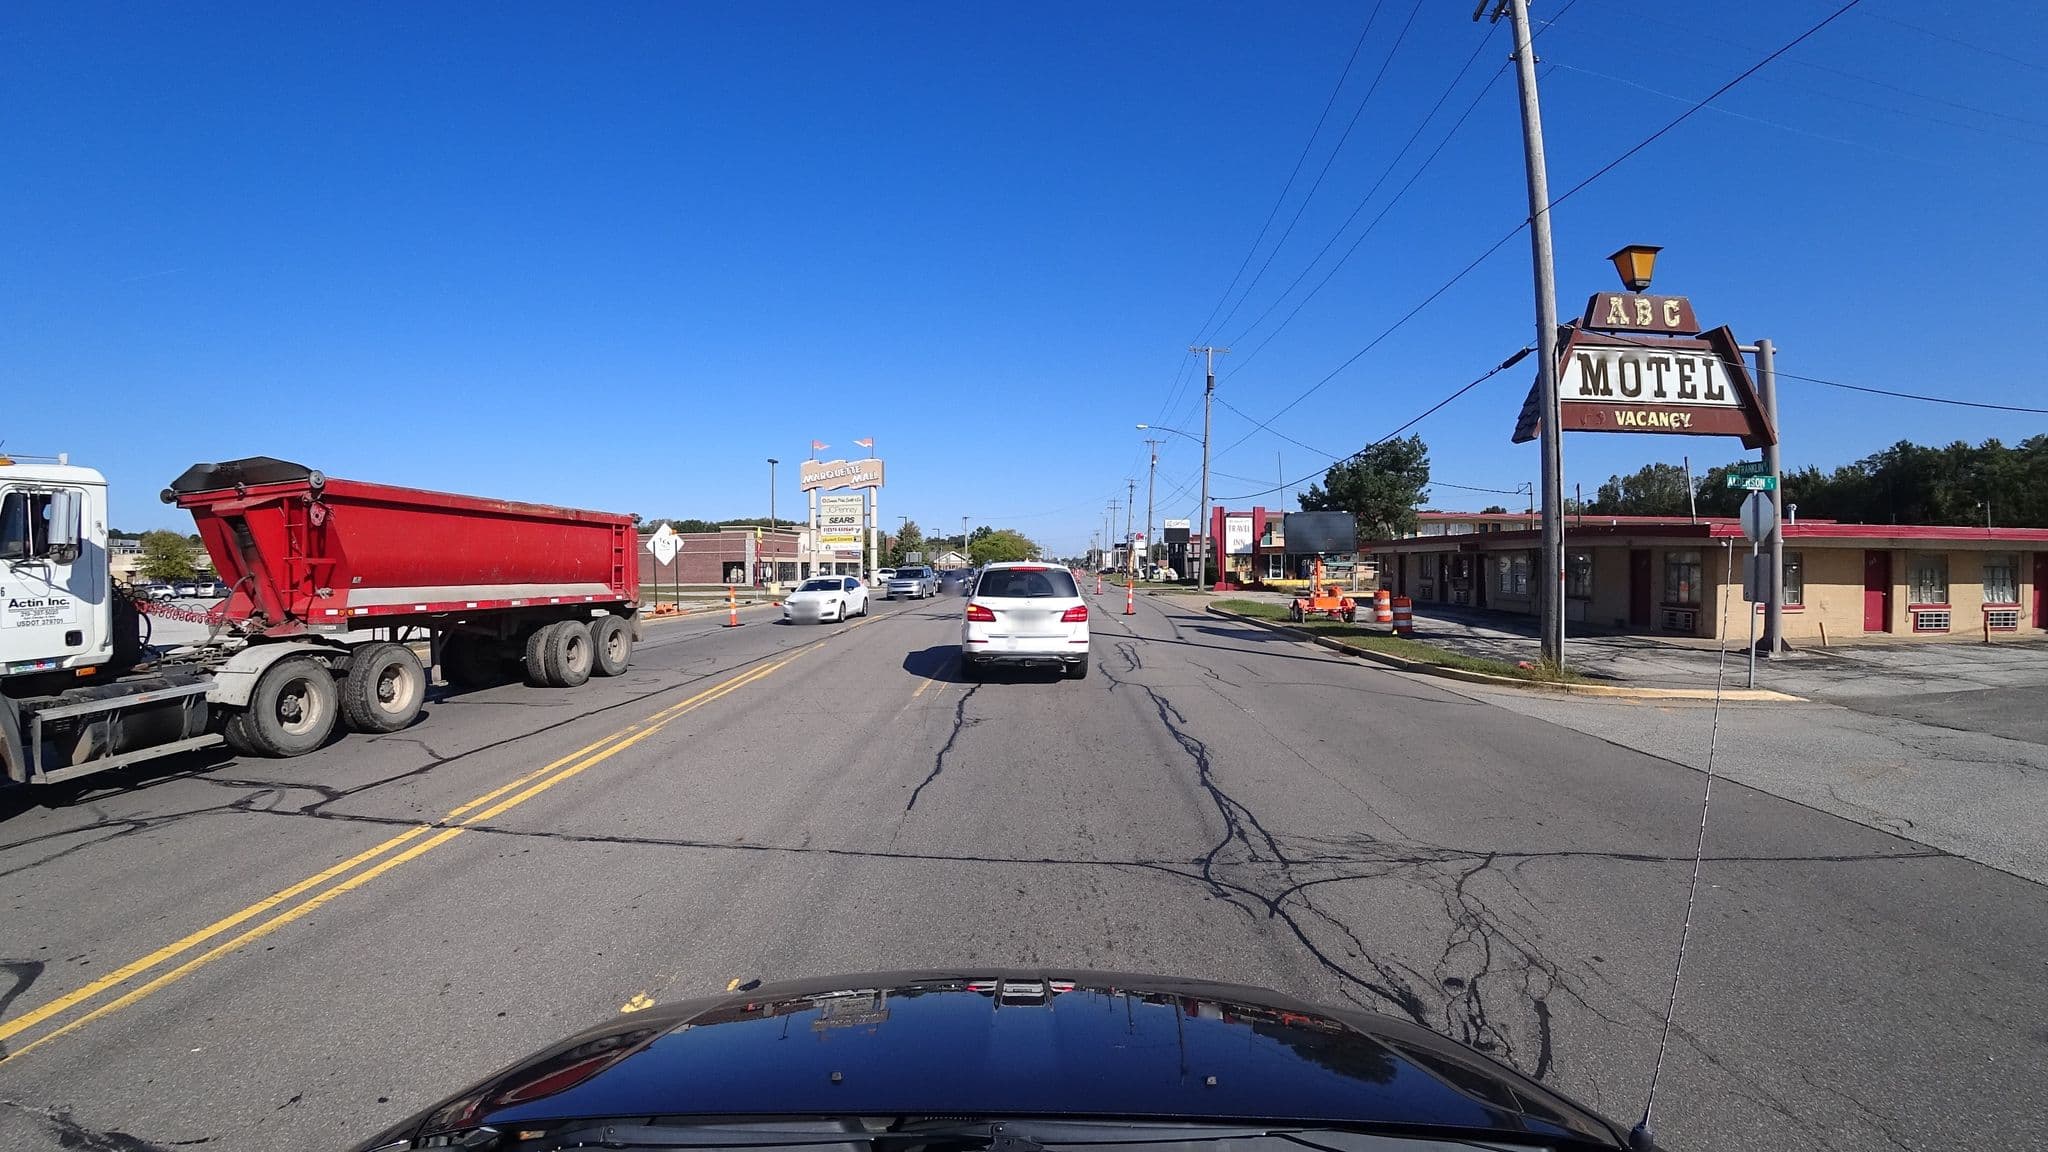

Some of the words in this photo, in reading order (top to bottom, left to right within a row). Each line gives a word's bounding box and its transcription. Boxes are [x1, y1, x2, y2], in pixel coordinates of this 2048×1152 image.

[1577, 352, 1725, 401] MOTEL
[1615, 410, 1693, 429] VACANCY
[802, 465, 862, 484] MARQUETTE
[850, 472, 880, 484] MALL
[828, 516, 856, 524] SEARS
[1228, 524, 1250, 533] TRAVEL
[1233, 538, 1246, 546] INN
[8, 598, 44, 608] Actin
[48, 597, 70, 606] Inc.
[17, 619, 40, 627] USDOT
